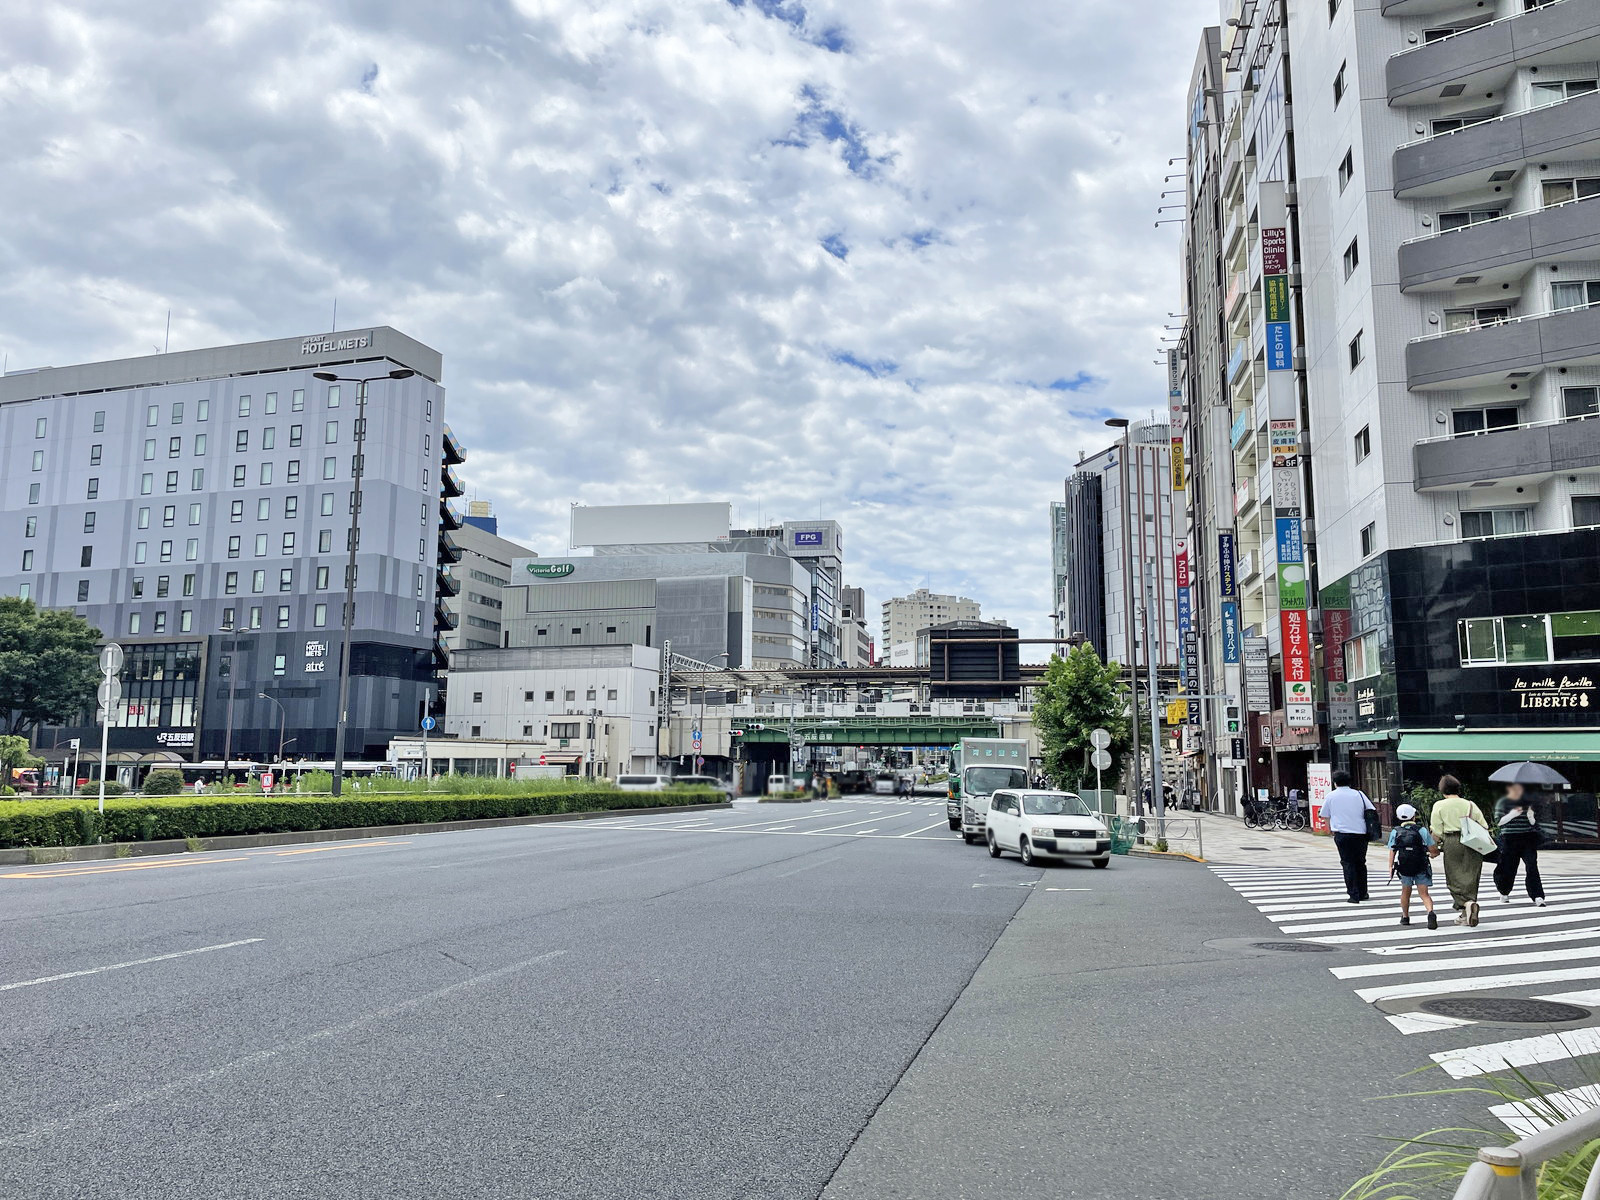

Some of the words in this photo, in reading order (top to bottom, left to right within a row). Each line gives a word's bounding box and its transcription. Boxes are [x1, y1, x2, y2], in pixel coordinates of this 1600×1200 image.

[1262, 229, 1285, 239] Lilly's
[1263, 238, 1286, 246] Sports
[1263, 246, 1285, 254] Clinic
[301, 341, 337, 354] HOTEL
[337, 337, 368, 350] METS
[1287, 508, 1300, 516] 4F
[550, 564, 570, 573] Golf
[1179, 560, 1187, 579] アコム
[1225, 619, 1235, 660] 東急リバブル
[1288, 612, 1304, 680] 処方せん受付
[305, 660, 325, 672] atré
[1514, 677, 1528, 689] les
[1531, 677, 1556, 688] mille
[1520, 693, 1578, 708] LIBERTÉ
[157, 733, 167, 742] JR
[167, 733, 194, 742] 五反田駅
